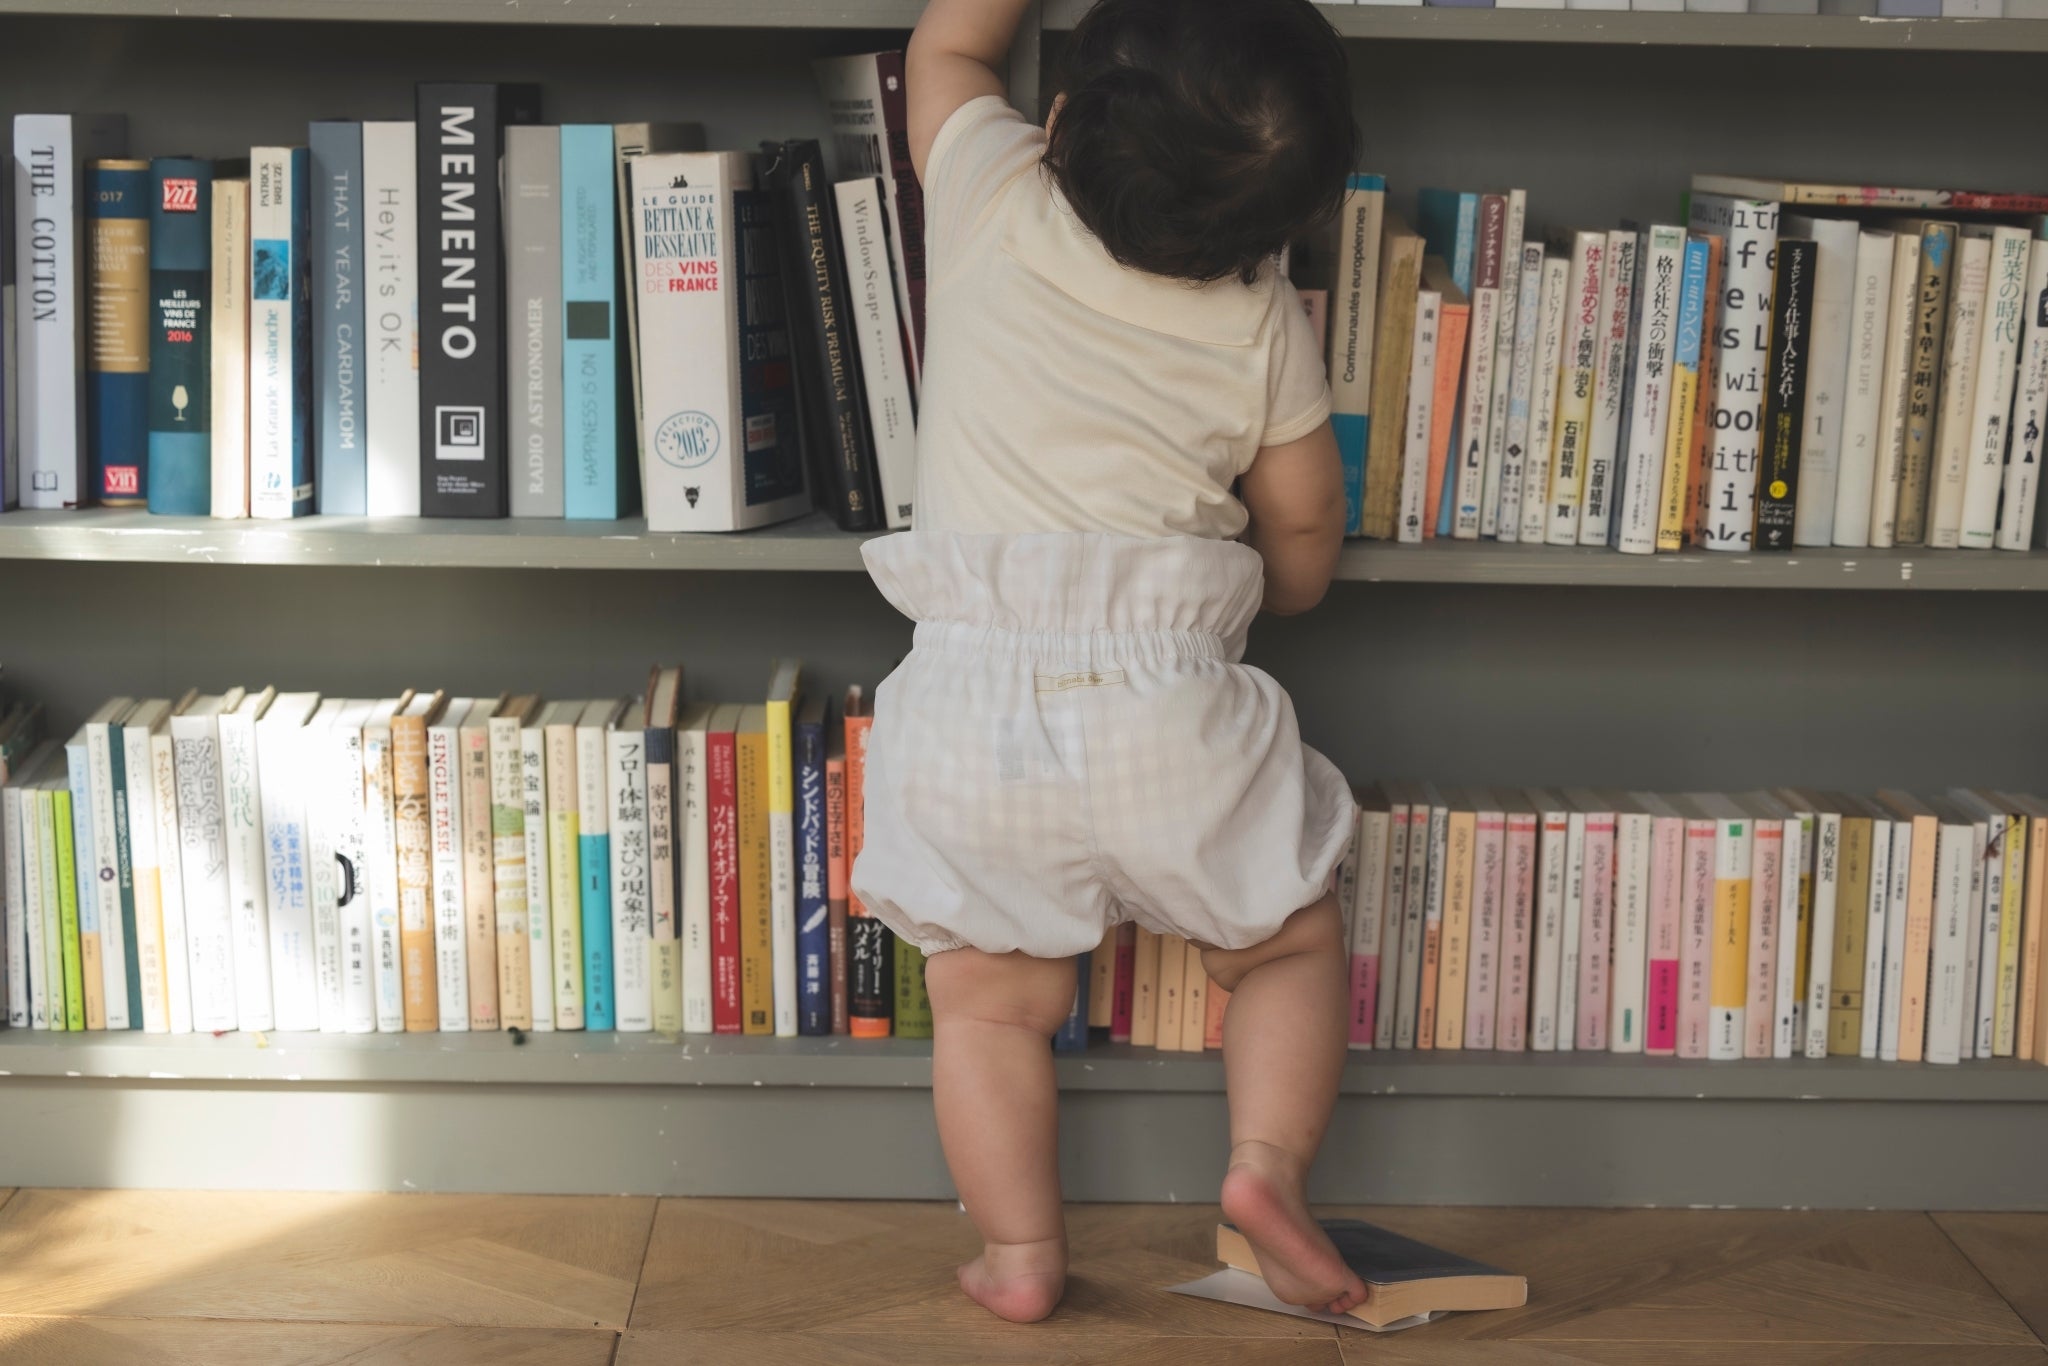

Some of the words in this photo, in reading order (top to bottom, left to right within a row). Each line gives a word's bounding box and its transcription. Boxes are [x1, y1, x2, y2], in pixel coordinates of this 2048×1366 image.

[31, 145, 55, 197] THE
[260, 162, 269, 207] PATRICK
[332, 170, 350, 232] THAT
[643, 197, 658, 206] LE
[668, 194, 714, 205] GUIDE
[644, 207, 703, 233] BETTANE
[706, 207, 714, 231] &
[806, 204, 821, 233] THE
[440, 107, 477, 359] MEMENTO
[644, 233, 717, 259] DESSEAUVE
[853, 200, 881, 321] WindowScape
[1352, 206, 1367, 289] européennes
[1482, 203, 1500, 287] ヴァン・ナチュール
[32, 217, 57, 323] COTTON
[173, 290, 187, 299] LES
[645, 262, 674, 277] DES
[678, 261, 718, 275] VINS
[646, 279, 665, 294] DE
[669, 278, 718, 292] FRANCE
[811, 240, 830, 296] EQUITY
[1863, 275, 1877, 307] OUR
[1994, 238, 2027, 344] 野菜の時代
[160, 299, 201, 308] MEILLEURS
[163, 319, 196, 328] FRANCE
[164, 309, 183, 319] VINS
[184, 309, 196, 319] DE
[820, 296, 836, 329] RISK
[1646, 254, 1674, 379] 格差社会の衝撃
[1680, 250, 1703, 353] ミニ・ミュンヘン
[168, 331, 192, 342] 2016
[265, 309, 279, 379] Avalanche
[527, 296, 544, 428] ASTRONOMER
[1343, 299, 1362, 383] Communautés
[1860, 311, 1875, 361] BOOKS
[336, 323, 356, 450] CARDAMOM
[580, 353, 597, 376] ON
[582, 382, 597, 395] IS
[827, 331, 849, 401] PREMIUM
[1857, 364, 1871, 397] LIFE
[265, 386, 279, 436] Grande
[265, 440, 279, 459] La
[528, 435, 545, 495] RADIO
[581, 402, 599, 487] HAPPINESS
[672, 427, 707, 460] 2013
[1856, 433, 1866, 448] 2
[1983, 414, 2001, 466] 瀬戸山玄
[1588, 458, 1606, 517] 石原結實
[1661, 529, 1682, 537] DVD
[226, 728, 254, 829] 野菜の時代
[433, 734, 448, 803] SINGLE
[523, 752, 541, 817] 地宝論
[617, 743, 643, 822] フロー体験
[435, 808, 450, 854] TASK
[651, 783, 669, 861] 家守綺譚
[801, 766, 822, 899] シンドバッドの冒険
[828, 772, 843, 858] 星の王子さま
[286, 822, 304, 909] 起業家精神に
[619, 830, 646, 932] 喜びの現象学
[712, 805, 731, 944] ソウル・オブ・マネー
[853, 924, 869, 960] ハメル
